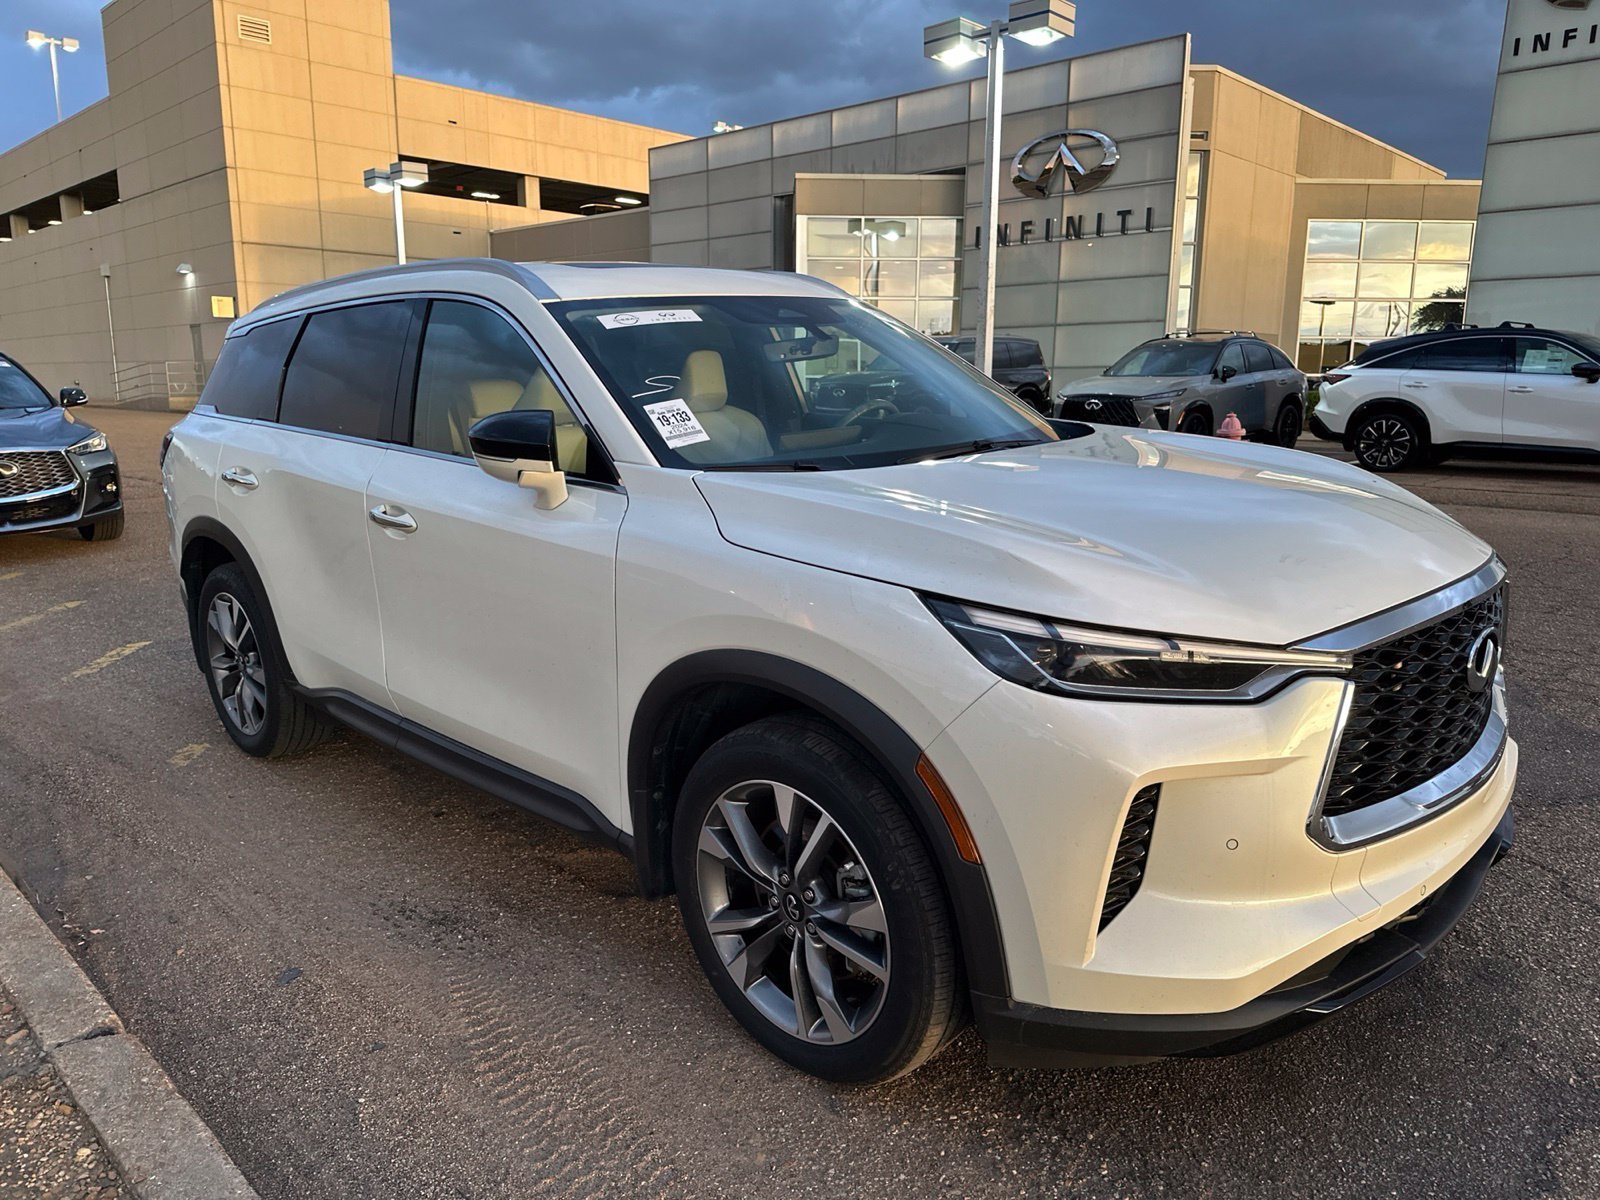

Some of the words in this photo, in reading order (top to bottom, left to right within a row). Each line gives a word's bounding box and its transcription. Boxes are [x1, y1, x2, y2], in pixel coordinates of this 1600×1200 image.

[1513, 24, 1598, 56] INFI
[975, 206, 1154, 249] INFINITI
[656, 410, 692, 427] 19:133
